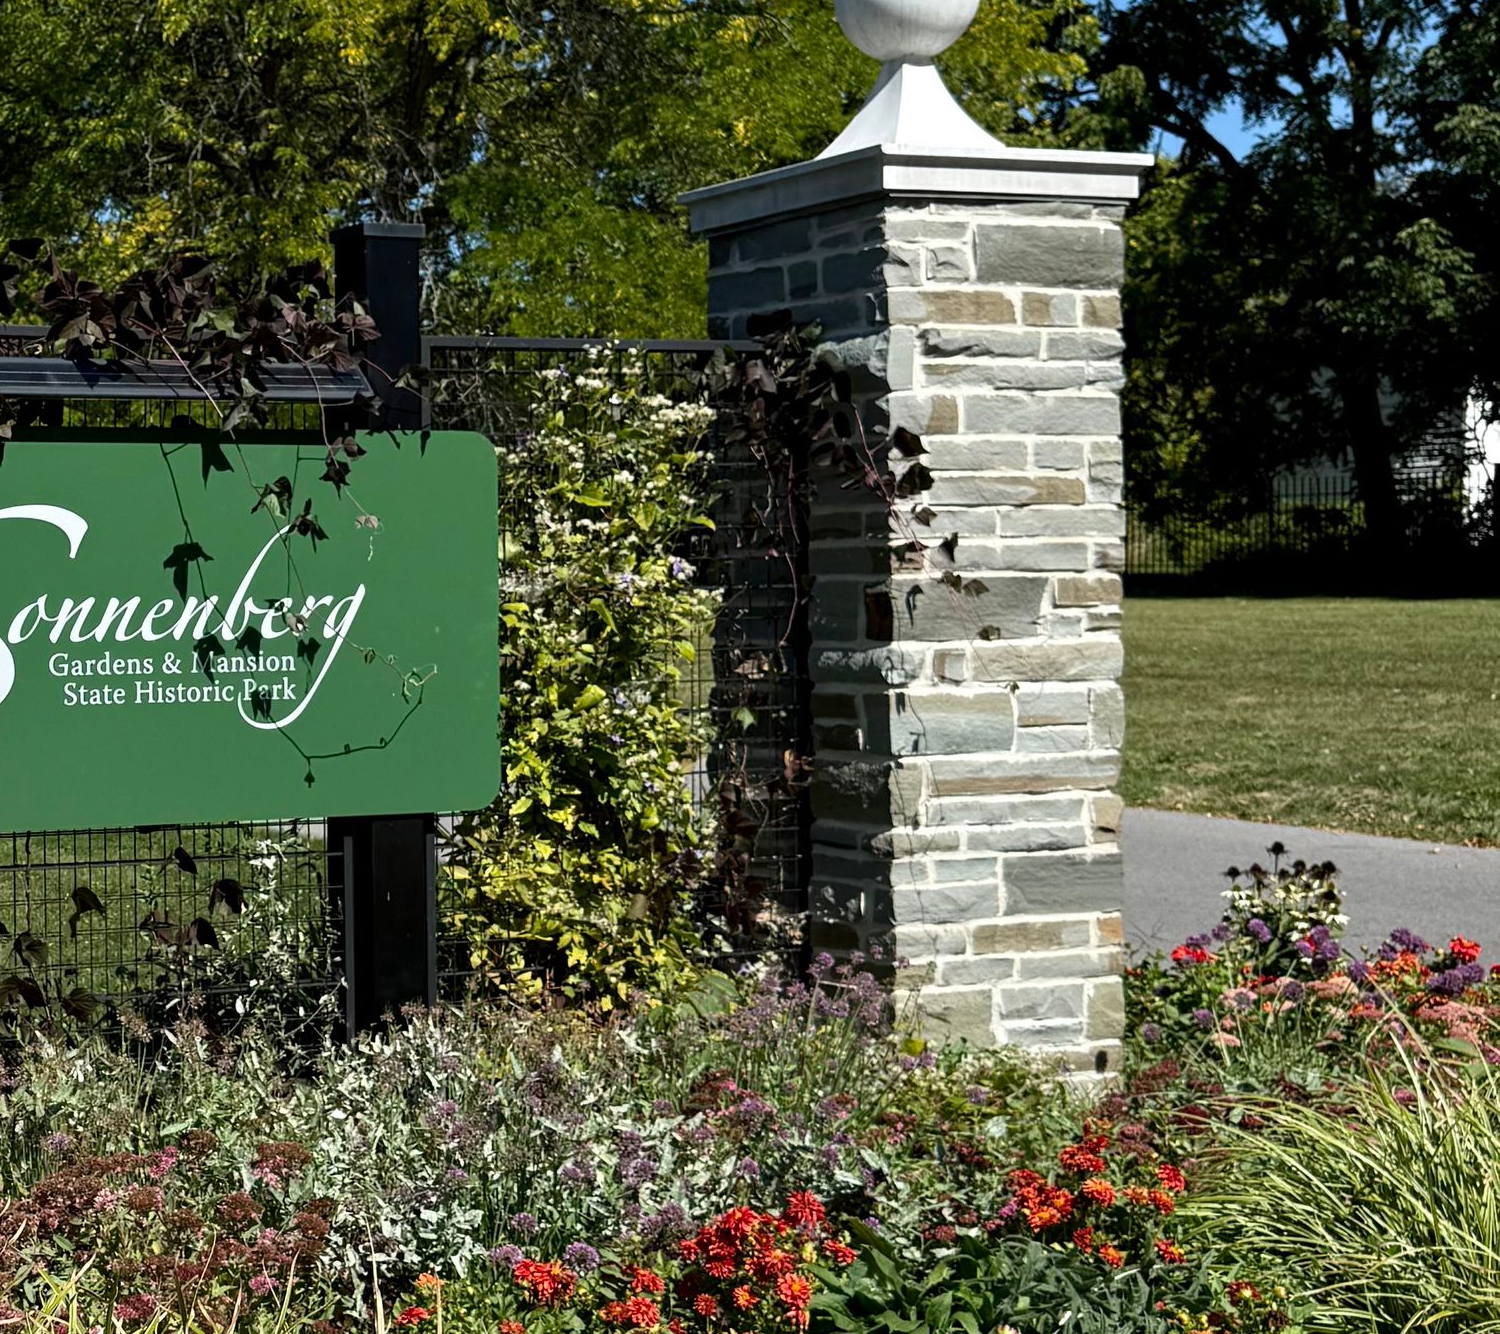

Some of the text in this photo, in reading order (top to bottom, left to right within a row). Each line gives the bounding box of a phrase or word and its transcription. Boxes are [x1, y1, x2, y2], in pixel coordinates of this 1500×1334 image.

[48, 649, 296, 677] Gardens & Mansion
[63, 676, 297, 706] State Historic Park
